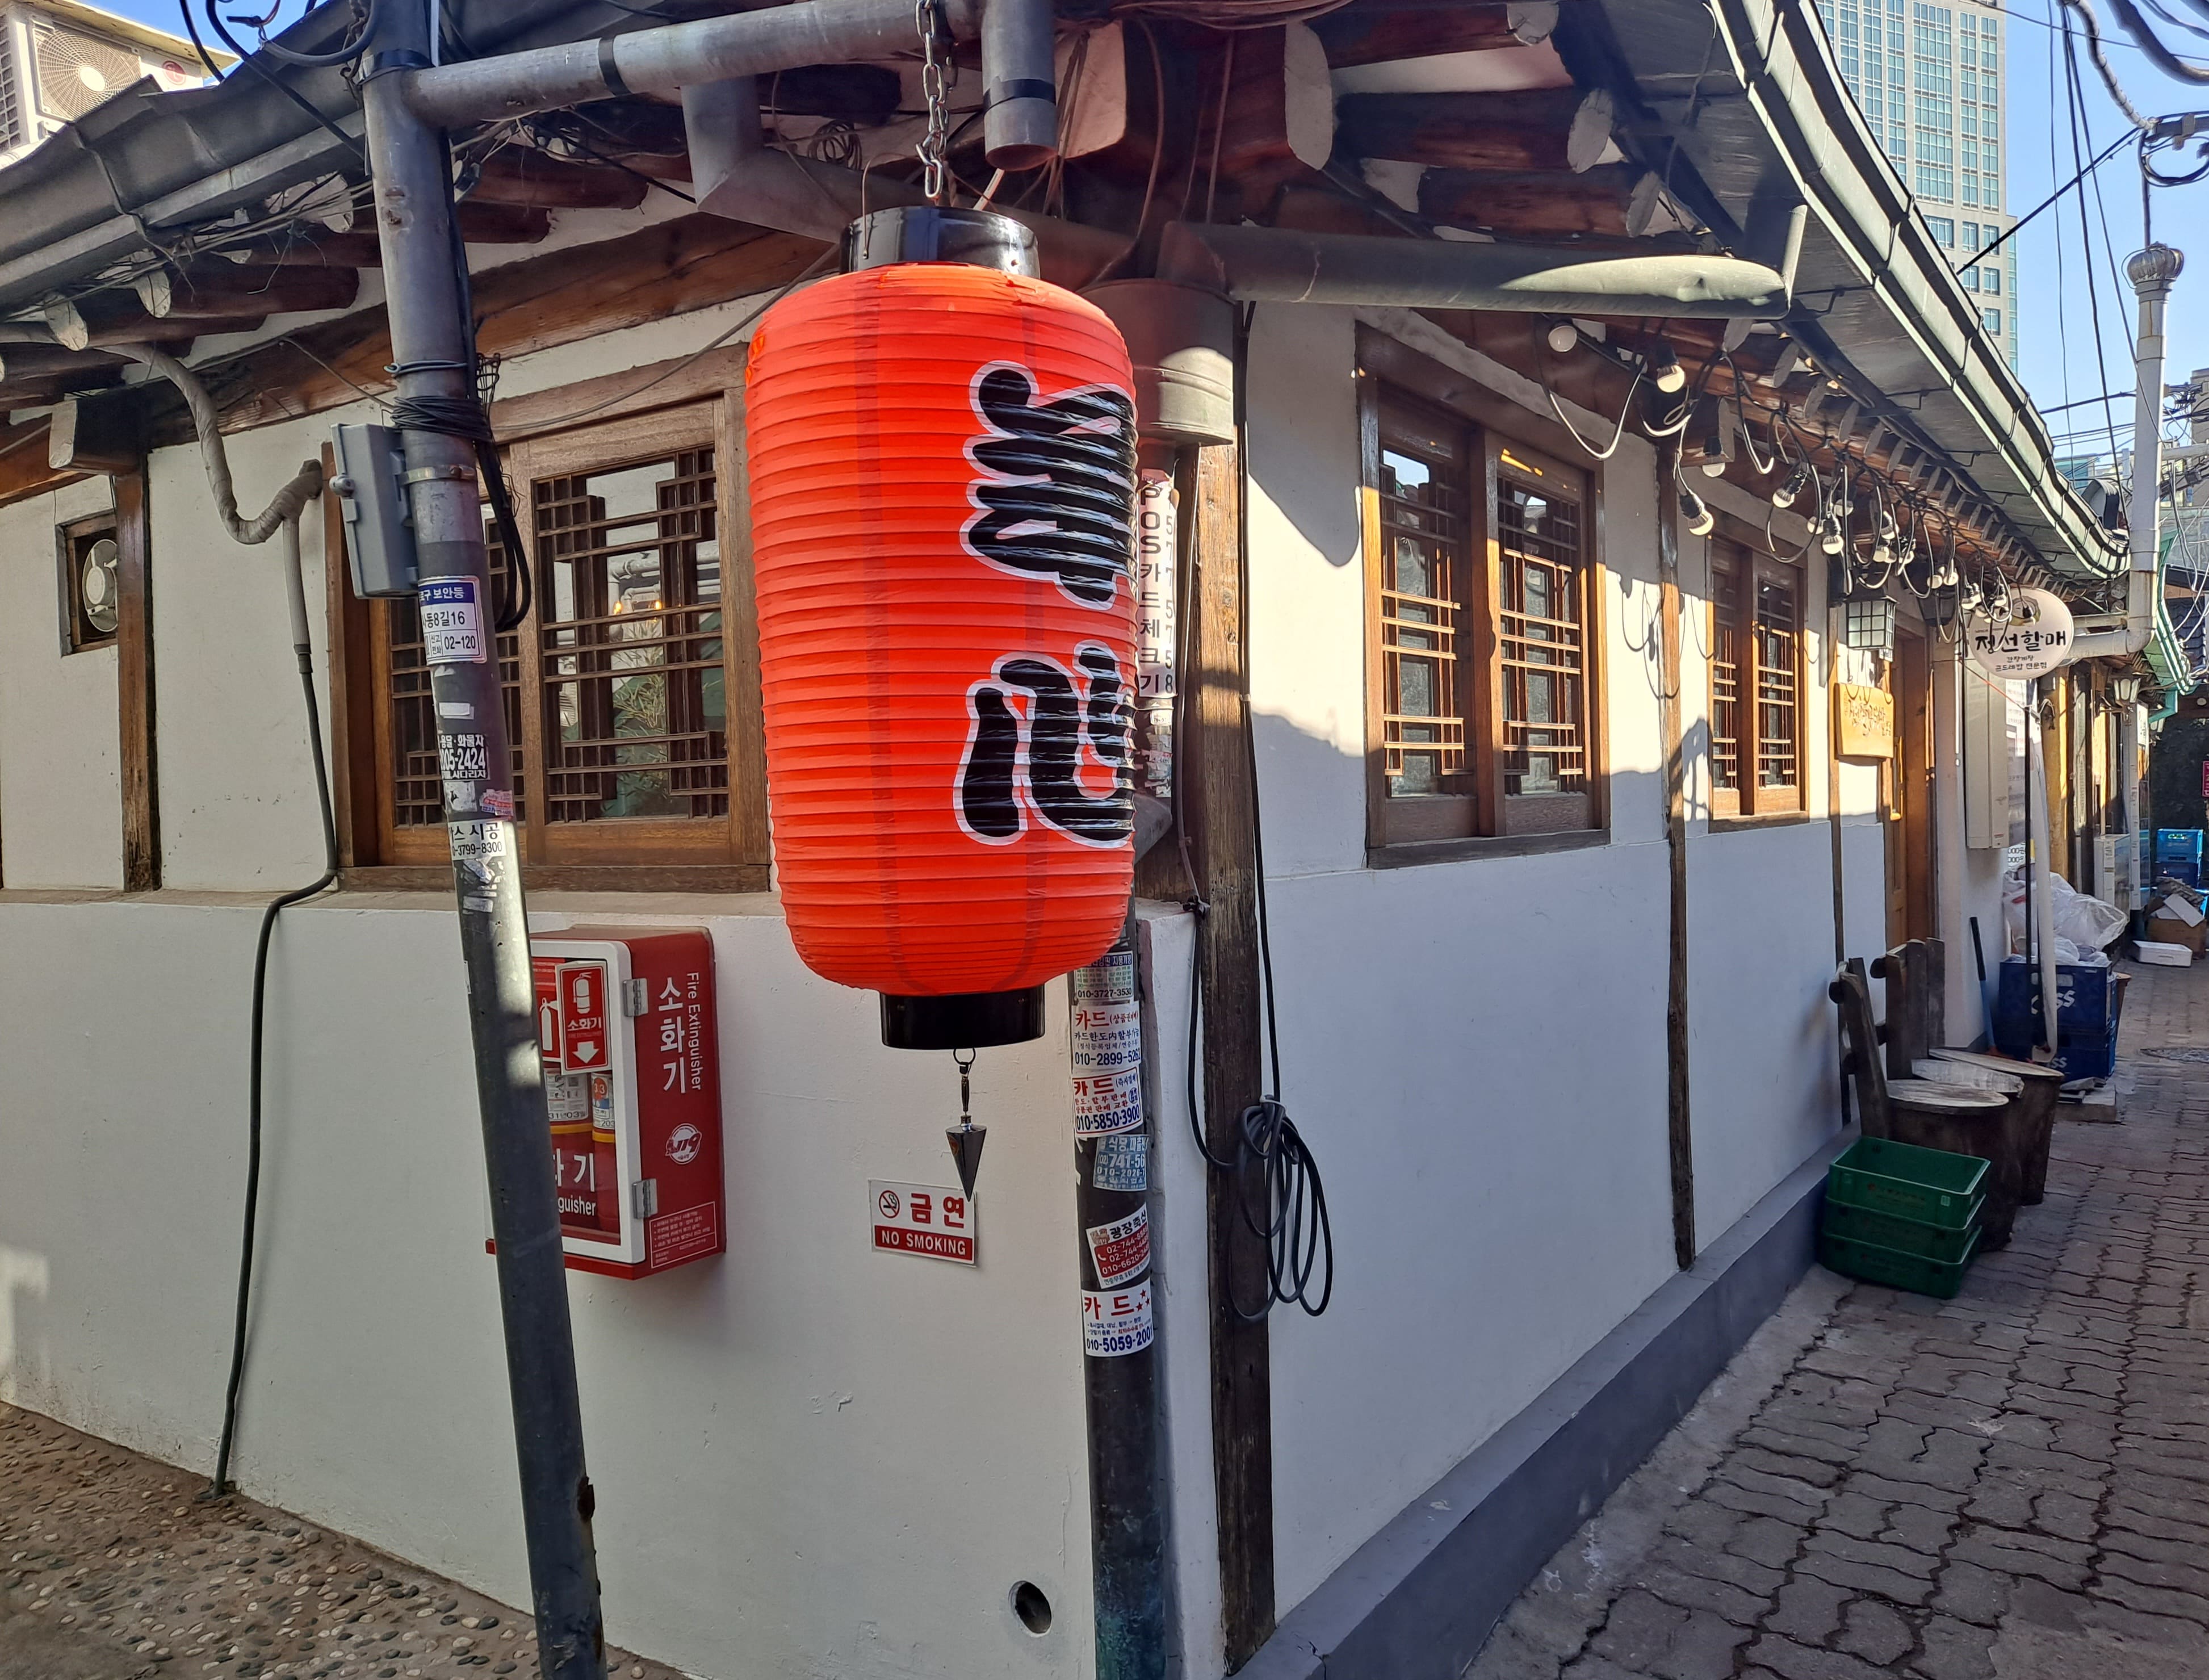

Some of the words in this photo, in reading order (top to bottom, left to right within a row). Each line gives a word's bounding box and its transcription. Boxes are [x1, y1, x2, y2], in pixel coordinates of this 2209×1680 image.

[433, 587, 465, 599] 보안등
[444, 635, 476, 650] 02-120
[686, 972, 699, 999] Fire
[567, 1017, 602, 1031] 소화기
[1075, 1009, 1110, 1031] 카드
[659, 977, 686, 1094] 소화기
[688, 1003, 703, 1091] Extinguisher
[1074, 1077, 1114, 1096] 카드
[910, 1193, 965, 1229] 금연
[881, 1230, 900, 1245] NO
[906, 1233, 966, 1255] SMOKING
[1084, 1294, 1135, 1320] 카드
